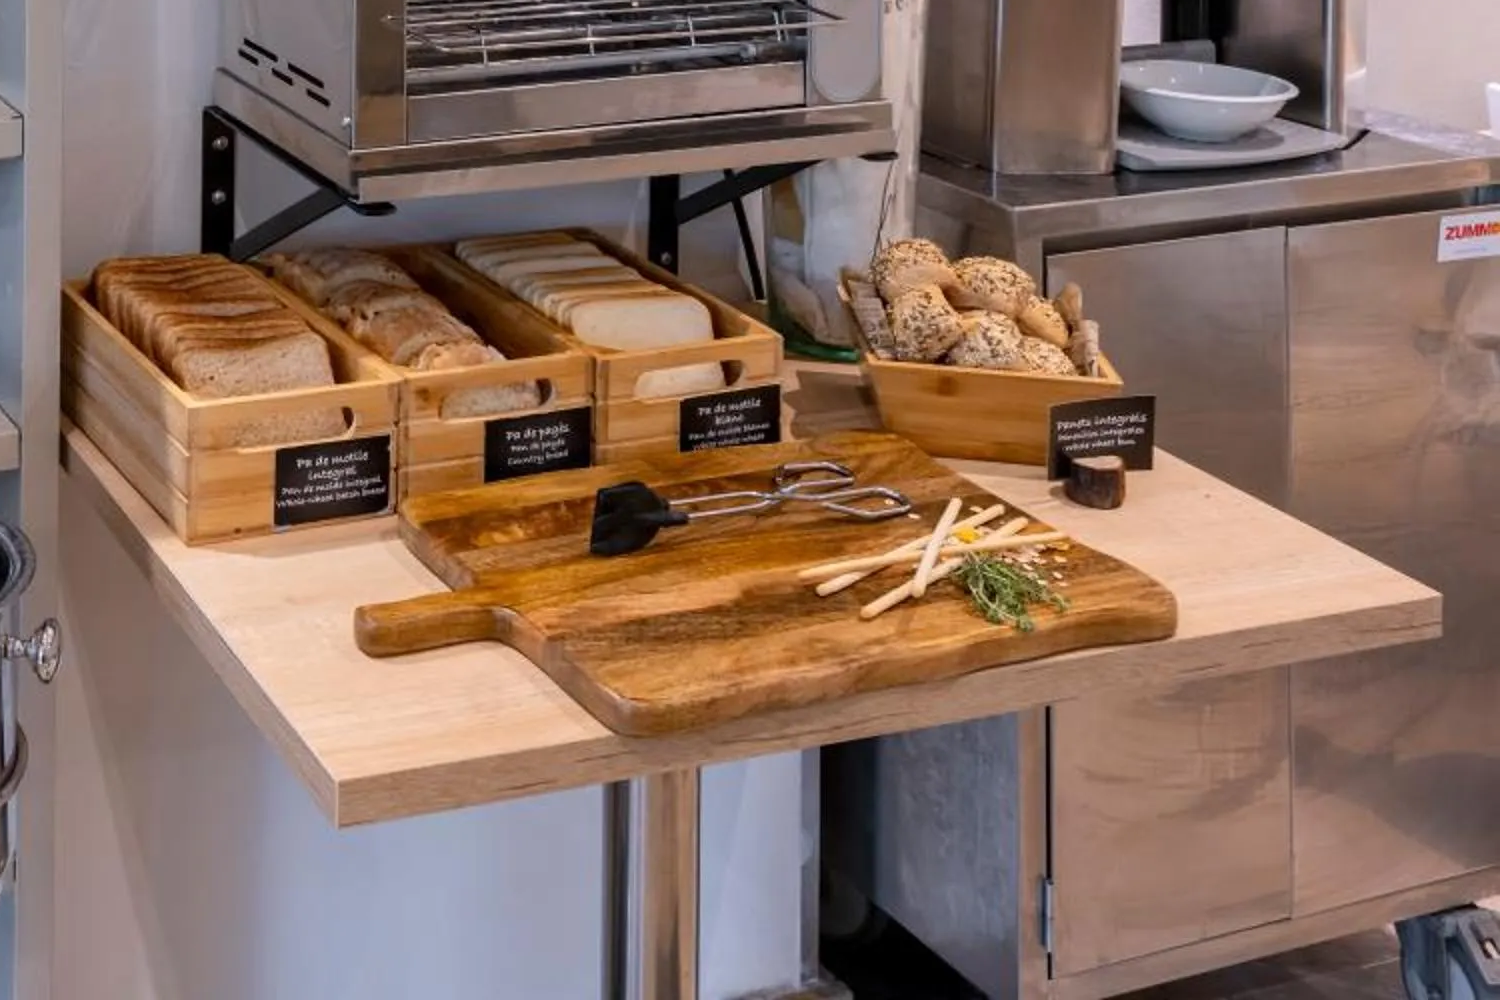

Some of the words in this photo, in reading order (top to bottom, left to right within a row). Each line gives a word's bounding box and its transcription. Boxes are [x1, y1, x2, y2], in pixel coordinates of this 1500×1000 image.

[713, 402, 726, 413] de
[315, 456, 329, 466] de
[308, 465, 357, 480] integral
